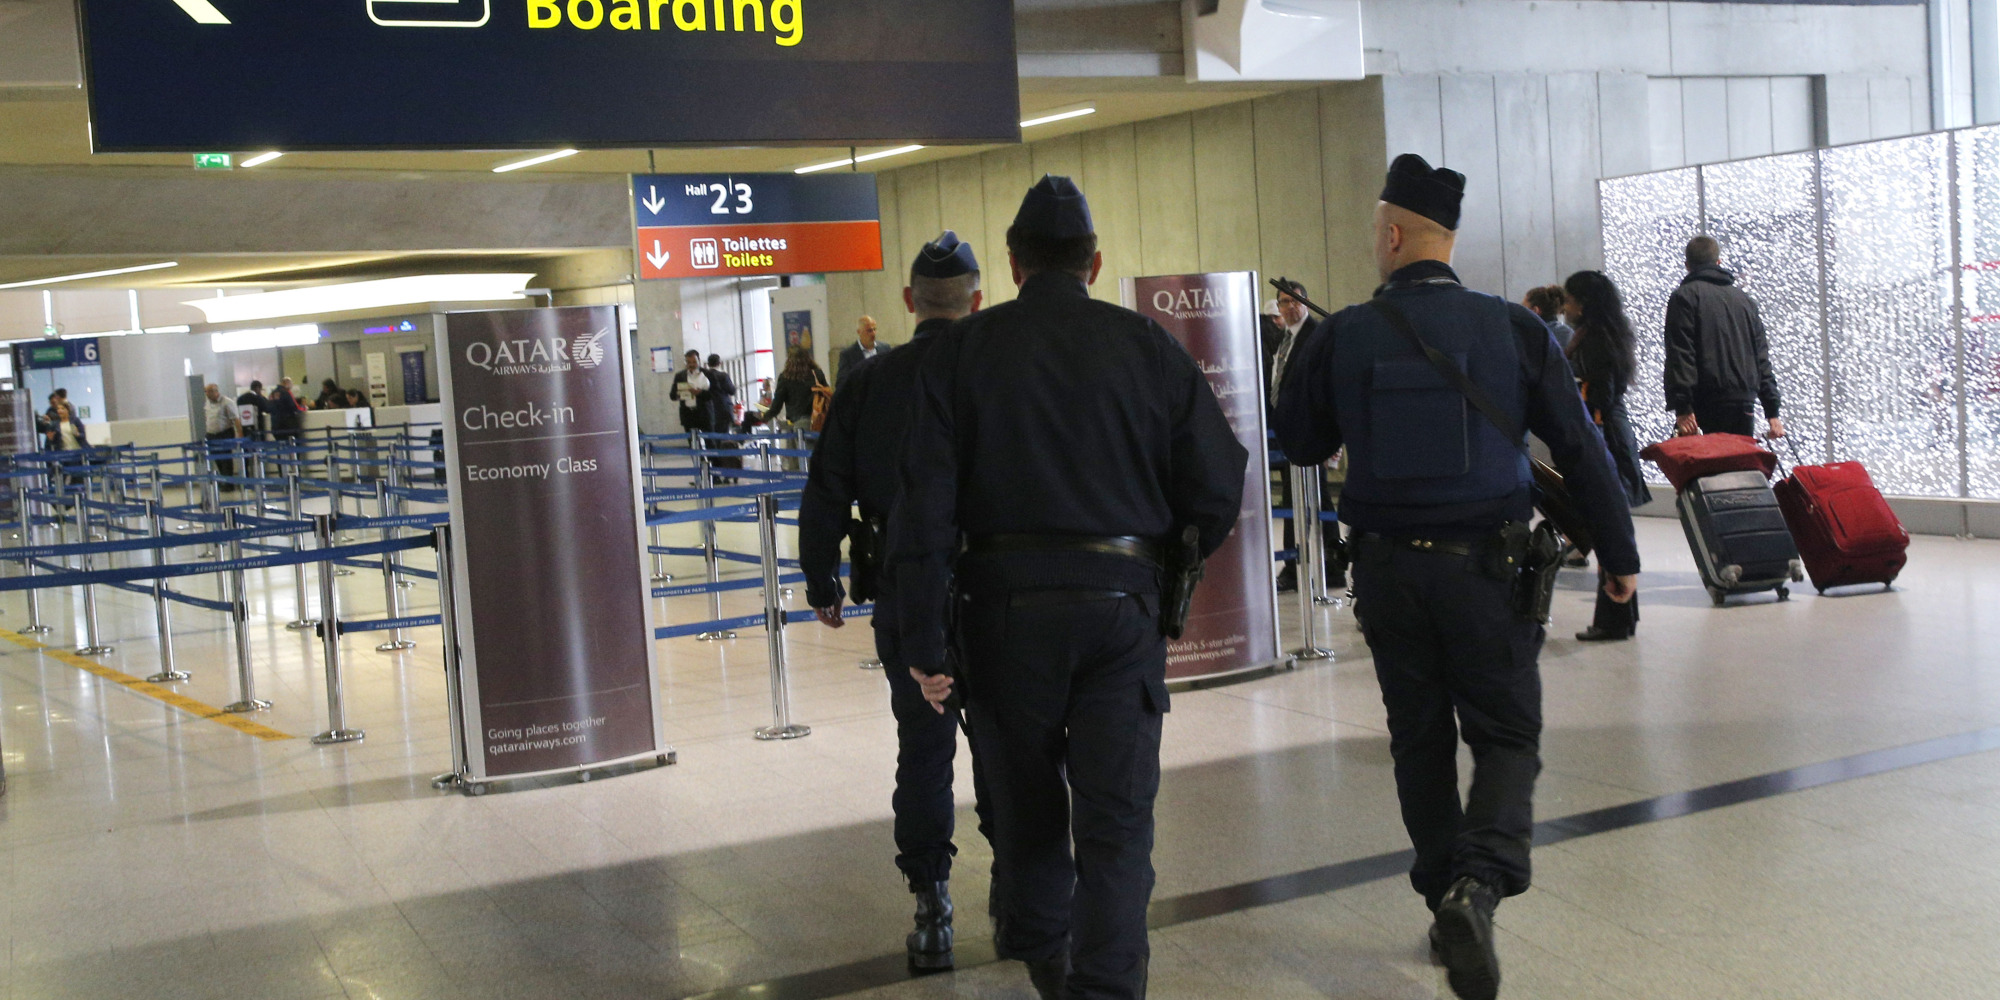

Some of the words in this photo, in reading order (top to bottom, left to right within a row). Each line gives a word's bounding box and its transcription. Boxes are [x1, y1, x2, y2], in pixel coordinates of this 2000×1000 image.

[526, 0, 804, 47] Boarding
[685, 183, 708, 196] Hall
[721, 237, 788, 252] Toilettes
[723, 253, 774, 268] Toilets
[1153, 287, 1225, 316] QATAR
[84, 343, 97, 361] 6
[466, 337, 571, 371] QATAR
[493, 363, 537, 376] AIRWAYS
[463, 401, 575, 431] Check-in
[466, 463, 550, 482] Economy
[556, 456, 598, 474] Class
[237, 561, 247, 569] DE
[248, 560, 268, 568] PARIS
[488, 727, 522, 740] Going
[526, 723, 560, 738] places
[562, 716, 606, 732] together
[489, 734, 587, 756] qatarairways.com
